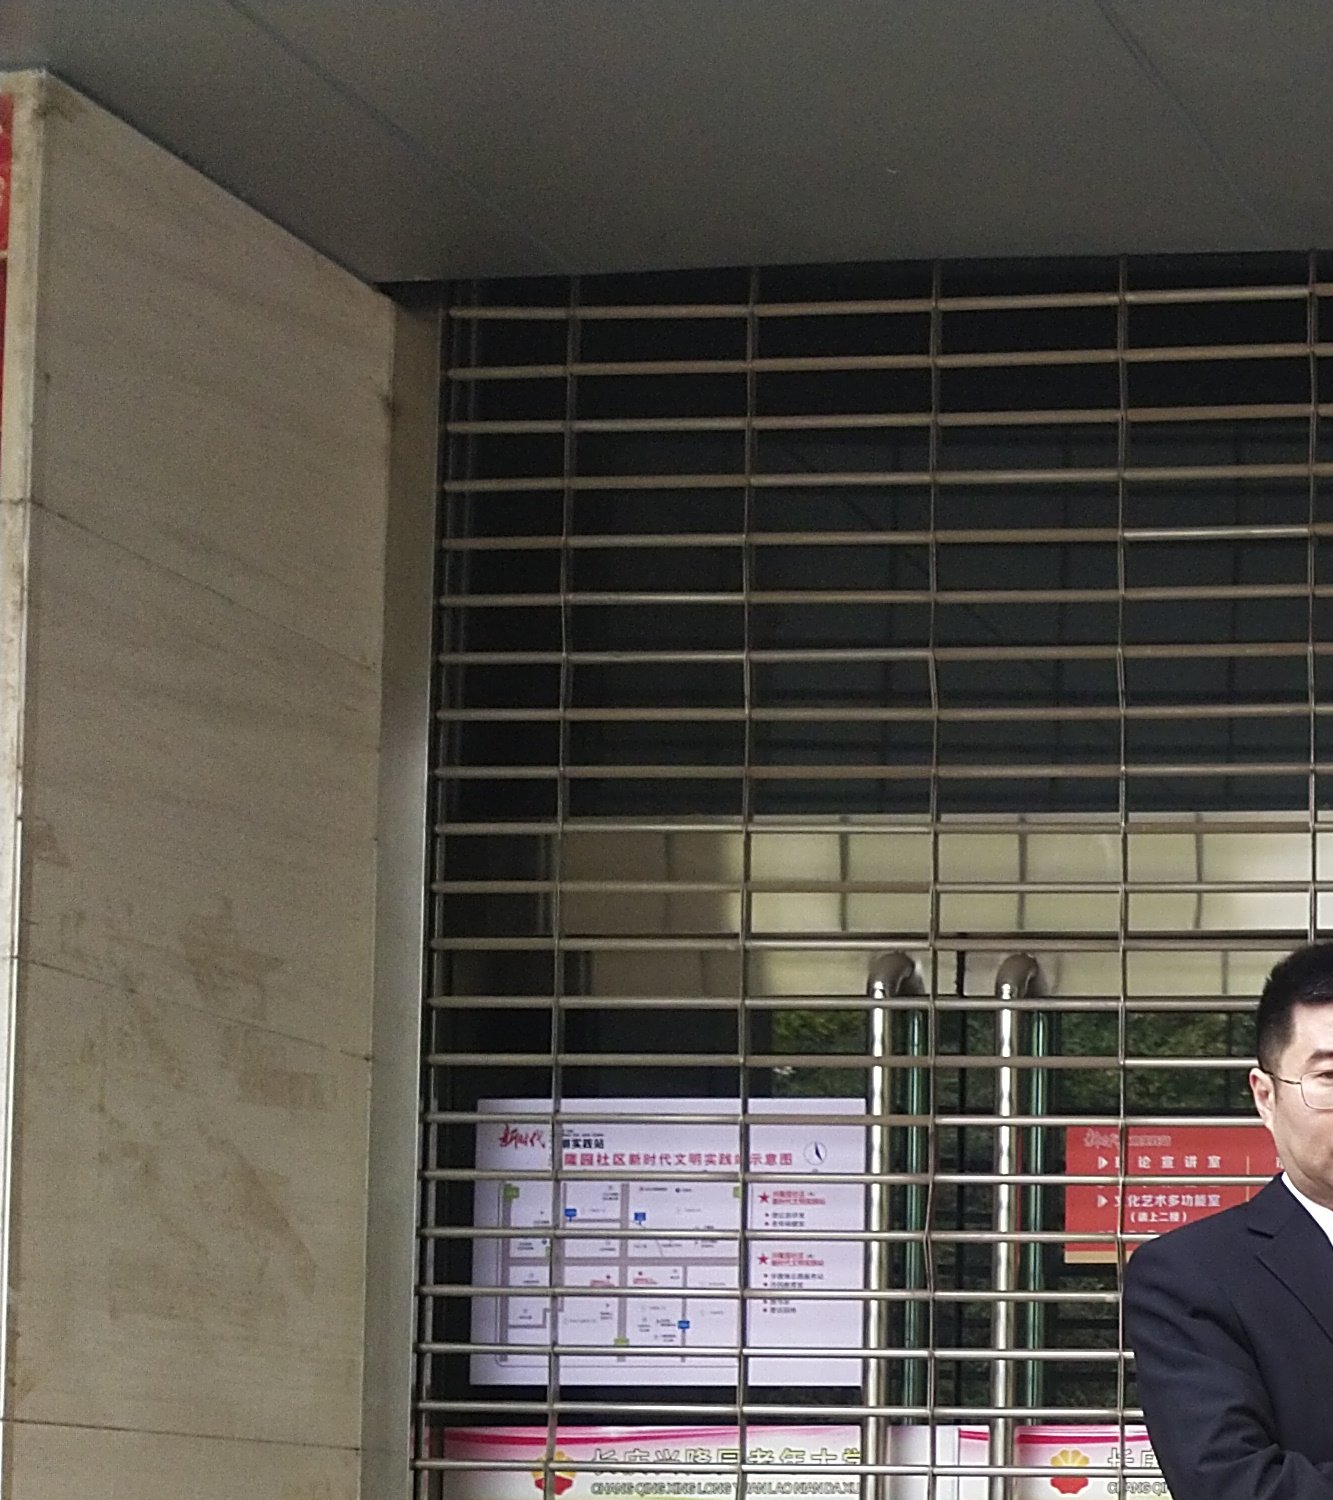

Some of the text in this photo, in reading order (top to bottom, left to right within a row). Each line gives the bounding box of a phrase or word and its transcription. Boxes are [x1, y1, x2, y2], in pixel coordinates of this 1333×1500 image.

[560, 1153, 793, 1168] 隆园社区新时代文明实践示意图
